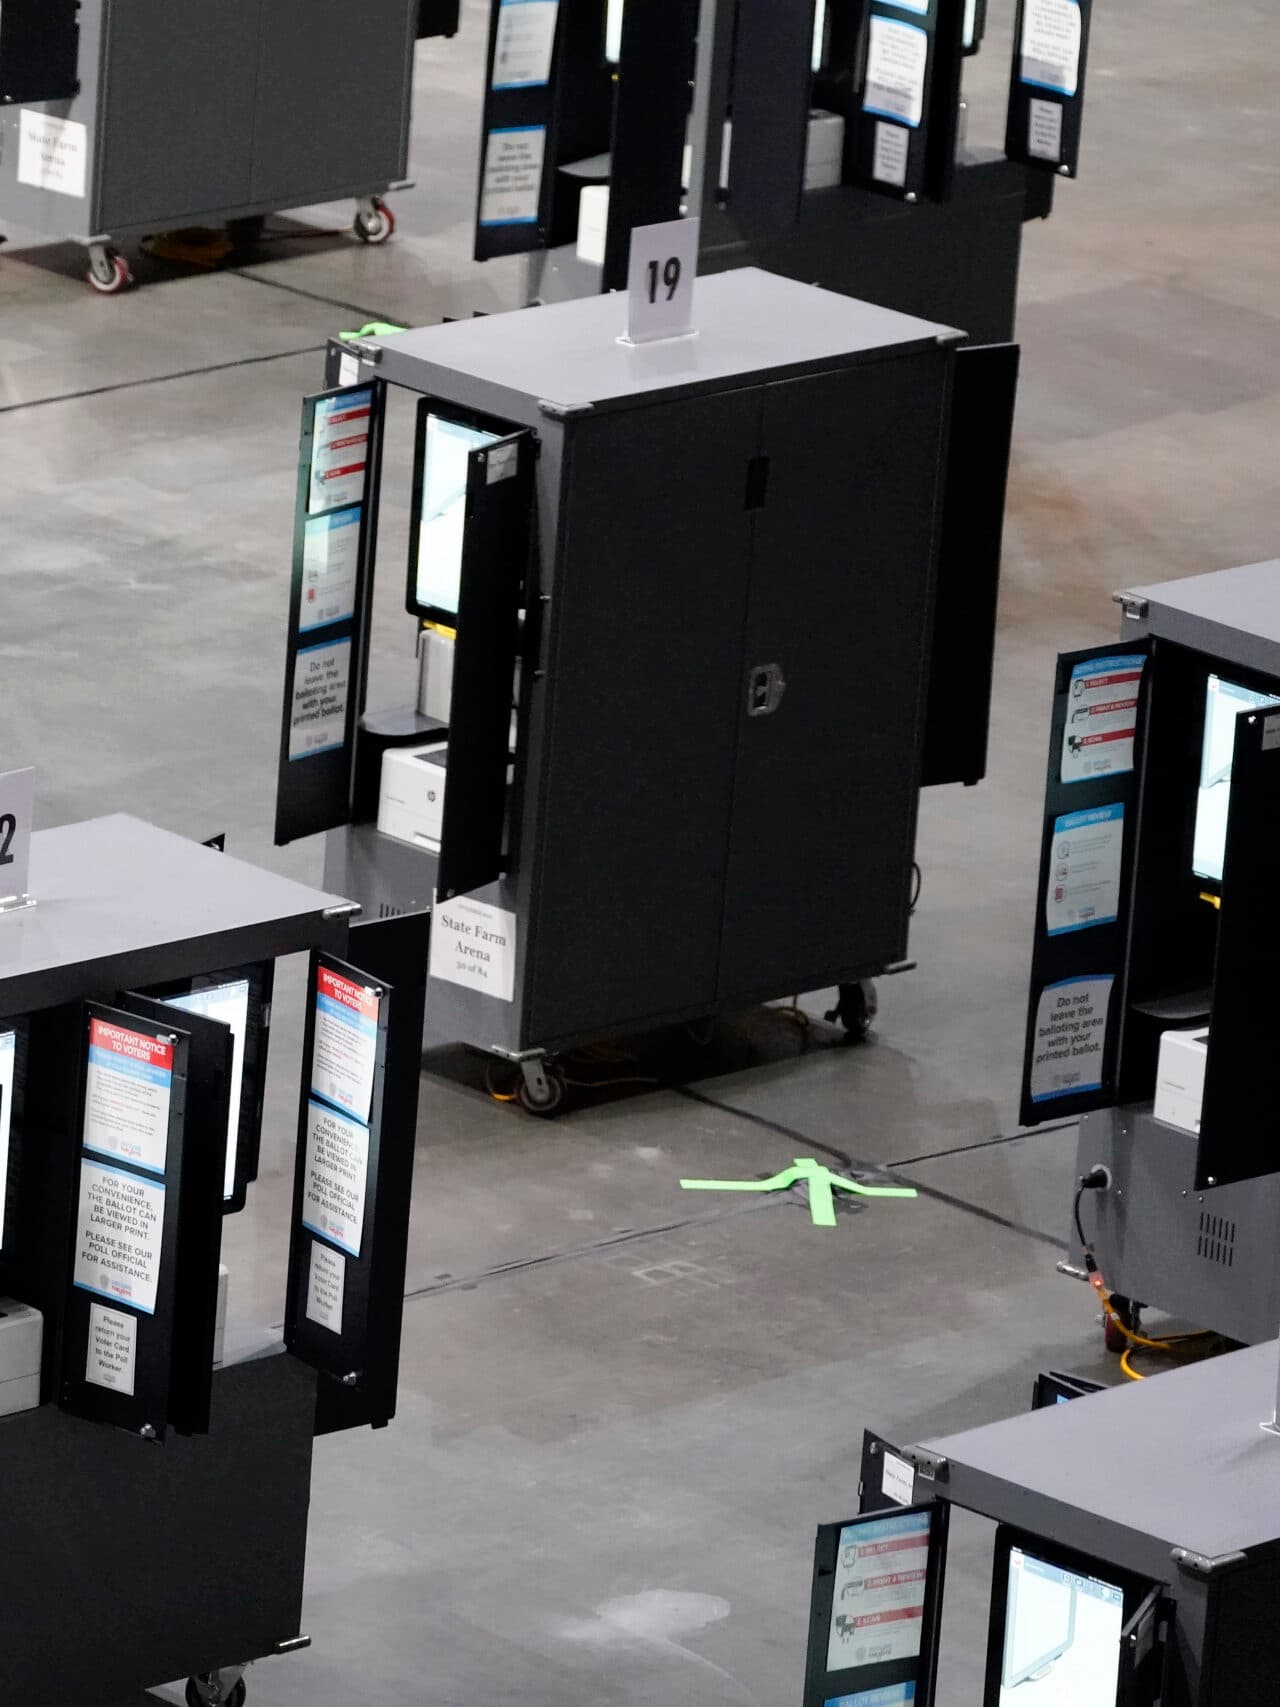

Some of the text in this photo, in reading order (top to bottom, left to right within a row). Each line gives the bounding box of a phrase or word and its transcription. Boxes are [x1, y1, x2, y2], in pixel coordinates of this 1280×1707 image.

[649, 257, 681, 304] 19
[441, 914, 506, 946] State Farm
[456, 941, 490, 962] Arena
[1057, 994, 1089, 1008] Do not
[1050, 1006, 1094, 1022] leave the
[1039, 1017, 1103, 1037] balloting area
[98, 1026, 166, 1056] IMPORTANT NOTICE
[1048, 1032, 1092, 1047] with your
[112, 1041, 150, 1061] TO VOTERS
[1037, 1048, 1070, 1064] printed
[324, 1117, 353, 1137] FOR YOUR
[313, 1132, 324, 1145] THE
[326, 1139, 348, 1156] BALLOT
[315, 1156, 337, 1172] LARGER
[317, 1145, 325, 1155] BE
[327, 1149, 349, 1167] VIEWED
[102, 1176, 144, 1197] FOR YOUR
[311, 1170, 359, 1200] PLEASE SEE OUR
[308, 1191, 320, 1203] FOR
[313, 1182, 355, 1210] POLL OFFICIAL
[88, 1192, 156, 1222] THE BALLOT CAN
[94, 1204, 148, 1229] BE VIEWED IN
[91, 1215, 122, 1231] LARGER
[86, 1230, 152, 1260] PLEASE SEE OUR
[89, 1242, 147, 1268] POLL OFFICIAL
[82, 1252, 98, 1263] FOR
